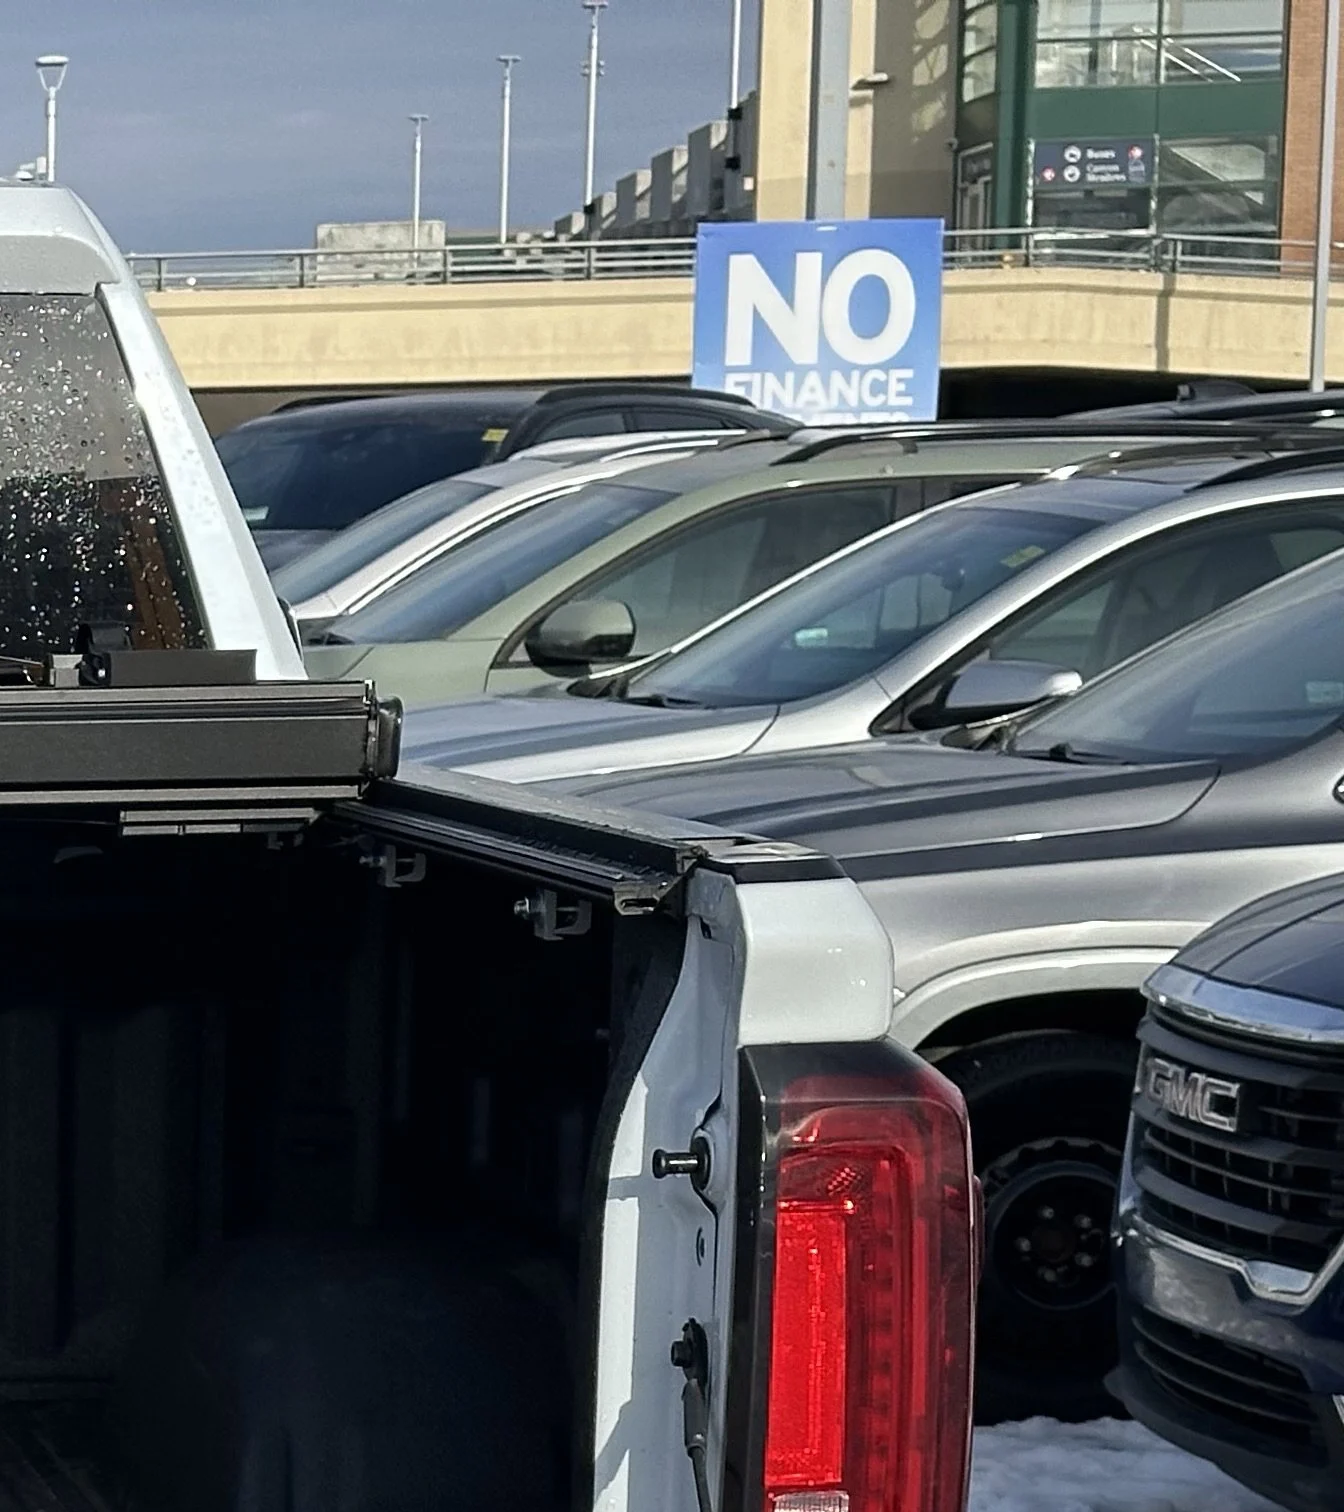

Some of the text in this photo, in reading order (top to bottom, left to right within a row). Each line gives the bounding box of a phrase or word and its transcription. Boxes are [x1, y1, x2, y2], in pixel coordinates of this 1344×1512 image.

[724, 248, 916, 366] NO
[724, 368, 914, 409] FINANCE
[1145, 1057, 1240, 1132] GMC
